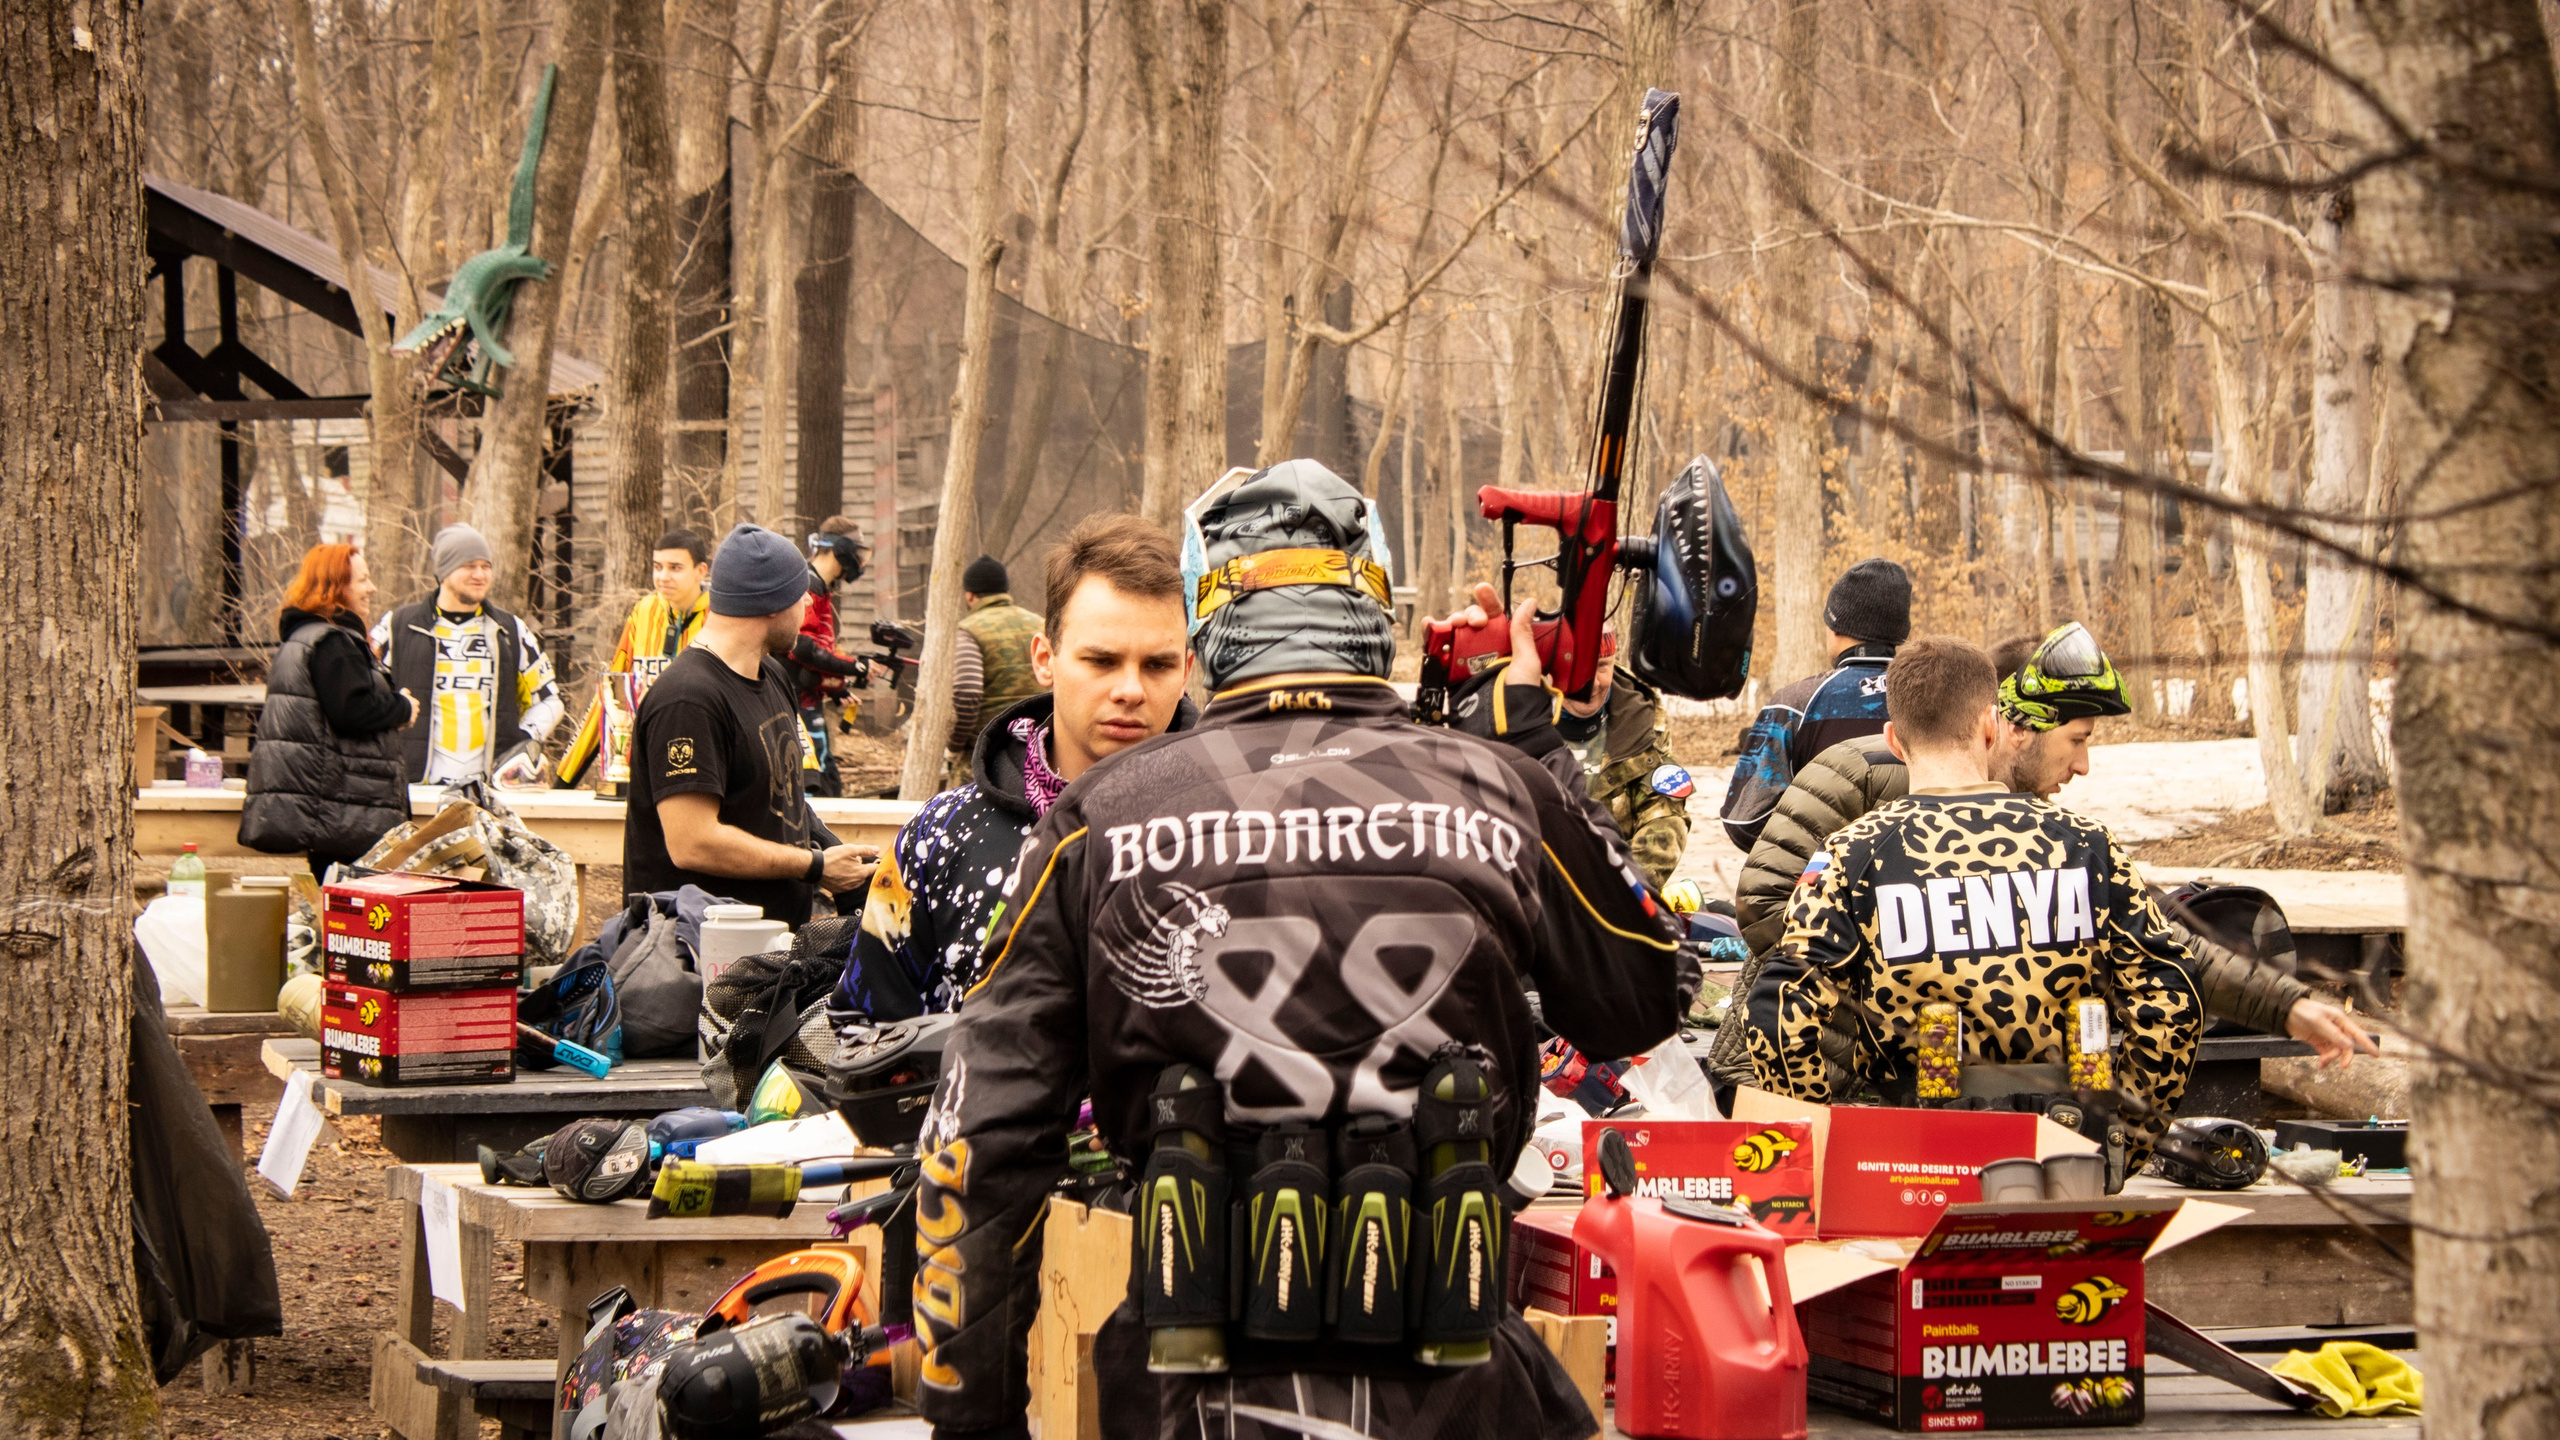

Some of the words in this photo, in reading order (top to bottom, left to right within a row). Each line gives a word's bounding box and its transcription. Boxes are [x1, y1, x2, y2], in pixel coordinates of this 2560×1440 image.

[1286, 747, 1350, 763] SLALOM
[1105, 802, 1521, 882] BONDARENKO
[1876, 867, 2094, 959] DENYA
[328, 933, 391, 961] BUMBLEBEE
[324, 1027, 380, 1057] BUMBLEBEE
[557, 1048, 594, 1068] EXALT
[1857, 1161, 1890, 1172] IGNITE
[1892, 1163, 1919, 1173] YOUR
[1921, 1164, 1954, 1174] DESIRE
[1956, 1165, 1969, 1175] TO
[1605, 1177, 1733, 1198] MBLEBEE
[1890, 1175, 1959, 1185] art-paintball.com
[1943, 1230, 2079, 1246] BUMBLEBEE
[1923, 1323, 1979, 1337] Paintballs
[1922, 1340, 2127, 1380] BUMBLEBEE
[1928, 1416, 1955, 1427] SINCE
[1957, 1415, 1978, 1426] 1997
